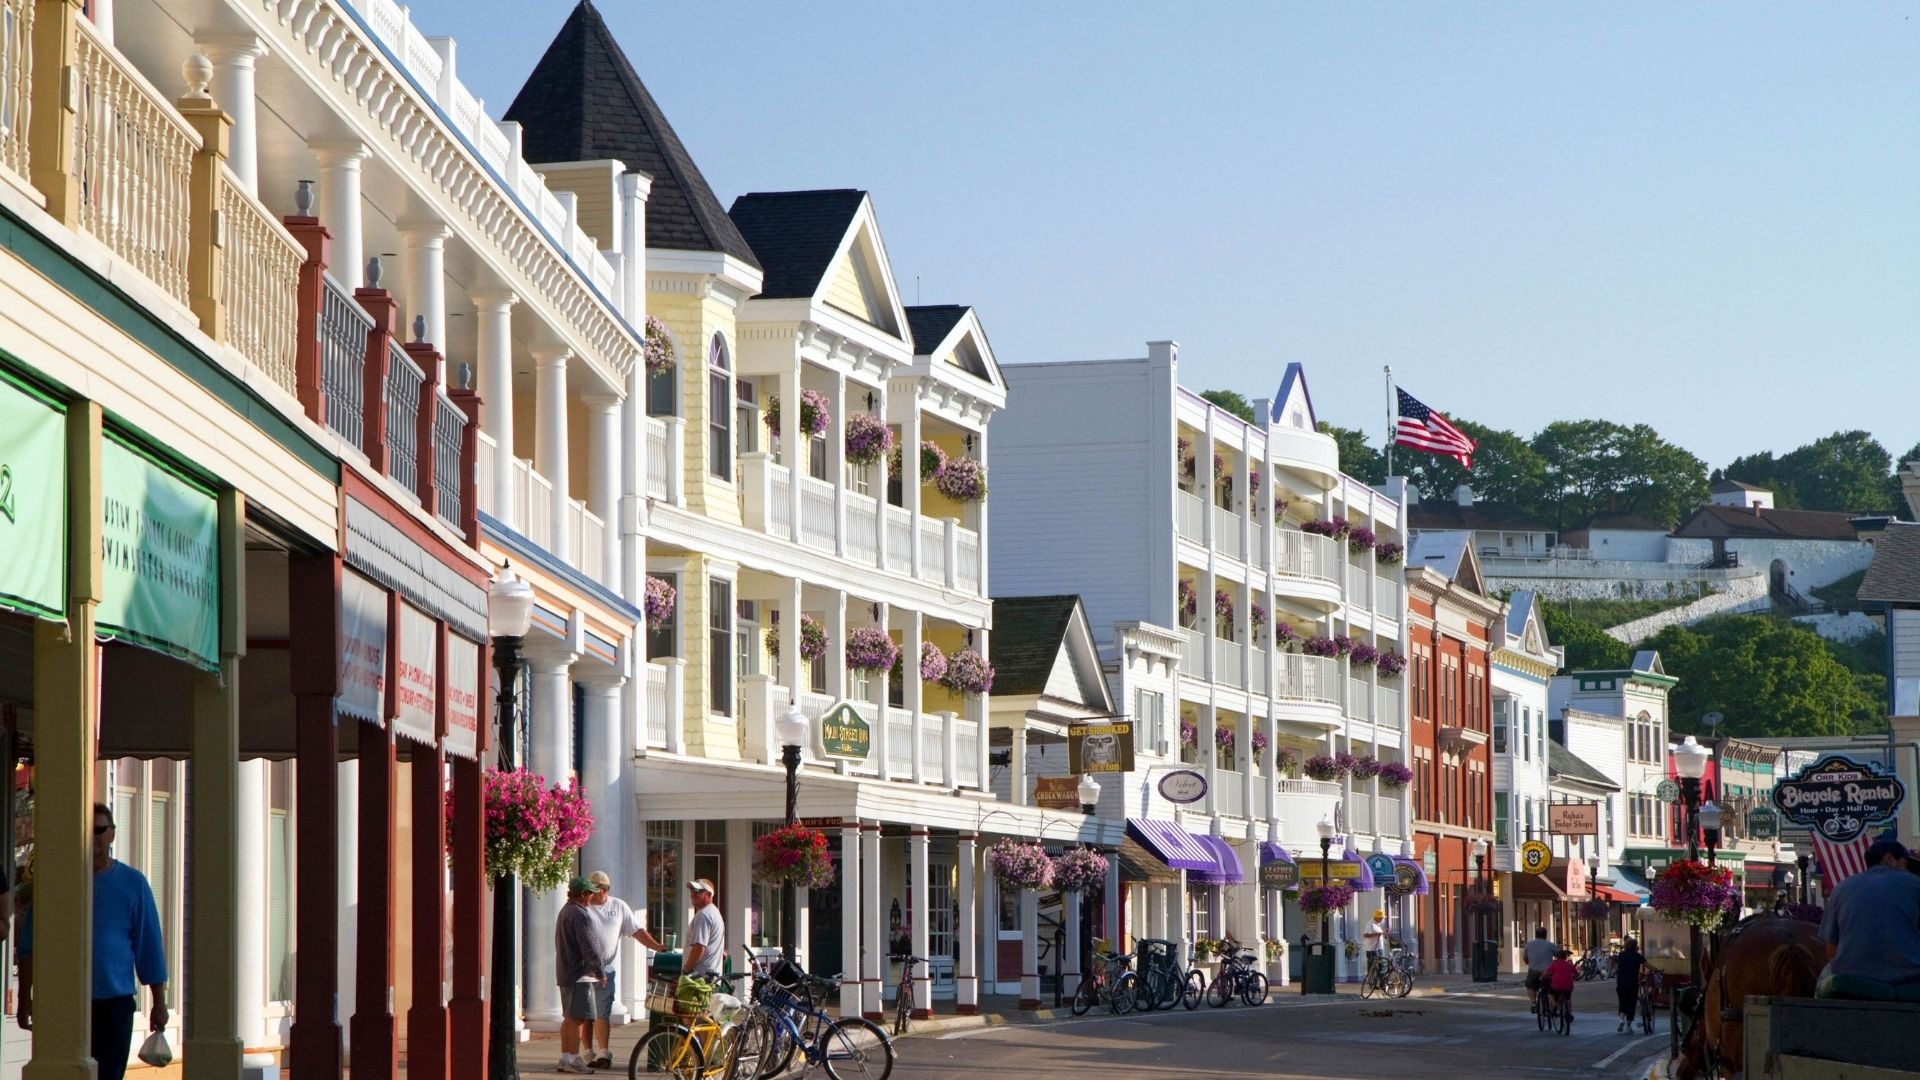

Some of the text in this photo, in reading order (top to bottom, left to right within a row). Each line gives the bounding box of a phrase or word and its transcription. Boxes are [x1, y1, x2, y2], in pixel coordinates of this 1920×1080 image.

[840, 726, 858, 741] STREET
[1070, 724, 1130, 736] GET SPOOKED
[1036, 790, 1079, 800] CHUCKWAGON
[1782, 783, 1895, 808] Bicycle Rental
[1825, 806, 1839, 814] Day
[1863, 804, 1878, 812] Day
[1562, 810, 1584, 820] Ryba's
[1750, 814, 1776, 822] HORN'S
[1554, 820, 1594, 830] Fudge Shops
[1756, 828, 1770, 836] BAR
[1264, 866, 1293, 874] LEATHER
